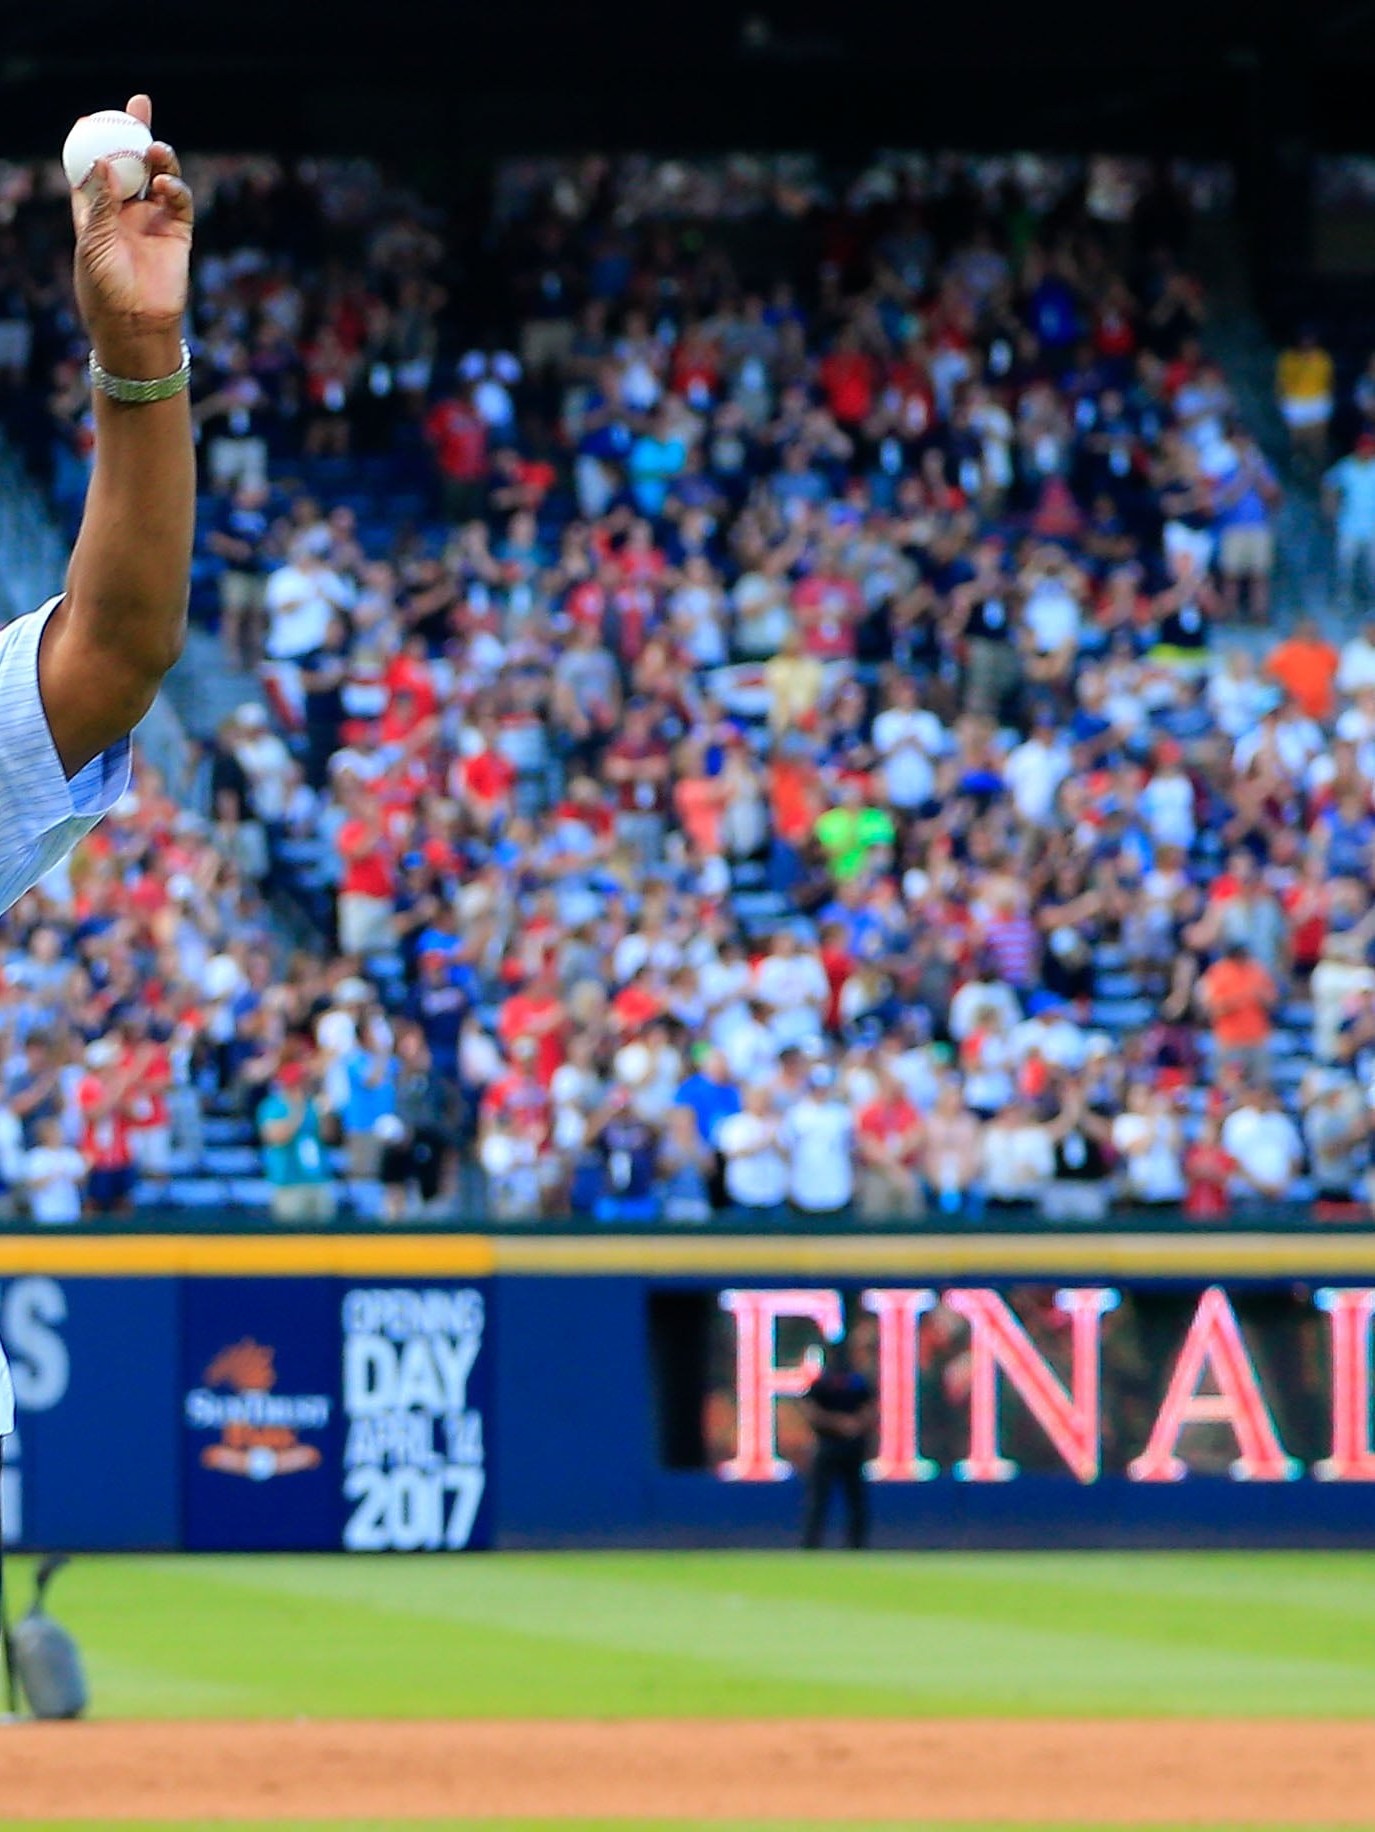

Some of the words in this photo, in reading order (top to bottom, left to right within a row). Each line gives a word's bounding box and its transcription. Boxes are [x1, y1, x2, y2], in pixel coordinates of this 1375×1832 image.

[342, 1289, 485, 1340] OPENING
[343, 1334, 483, 1415] DAY
[344, 1414, 443, 1474] APRIL
[342, 1466, 485, 1550] 2017
